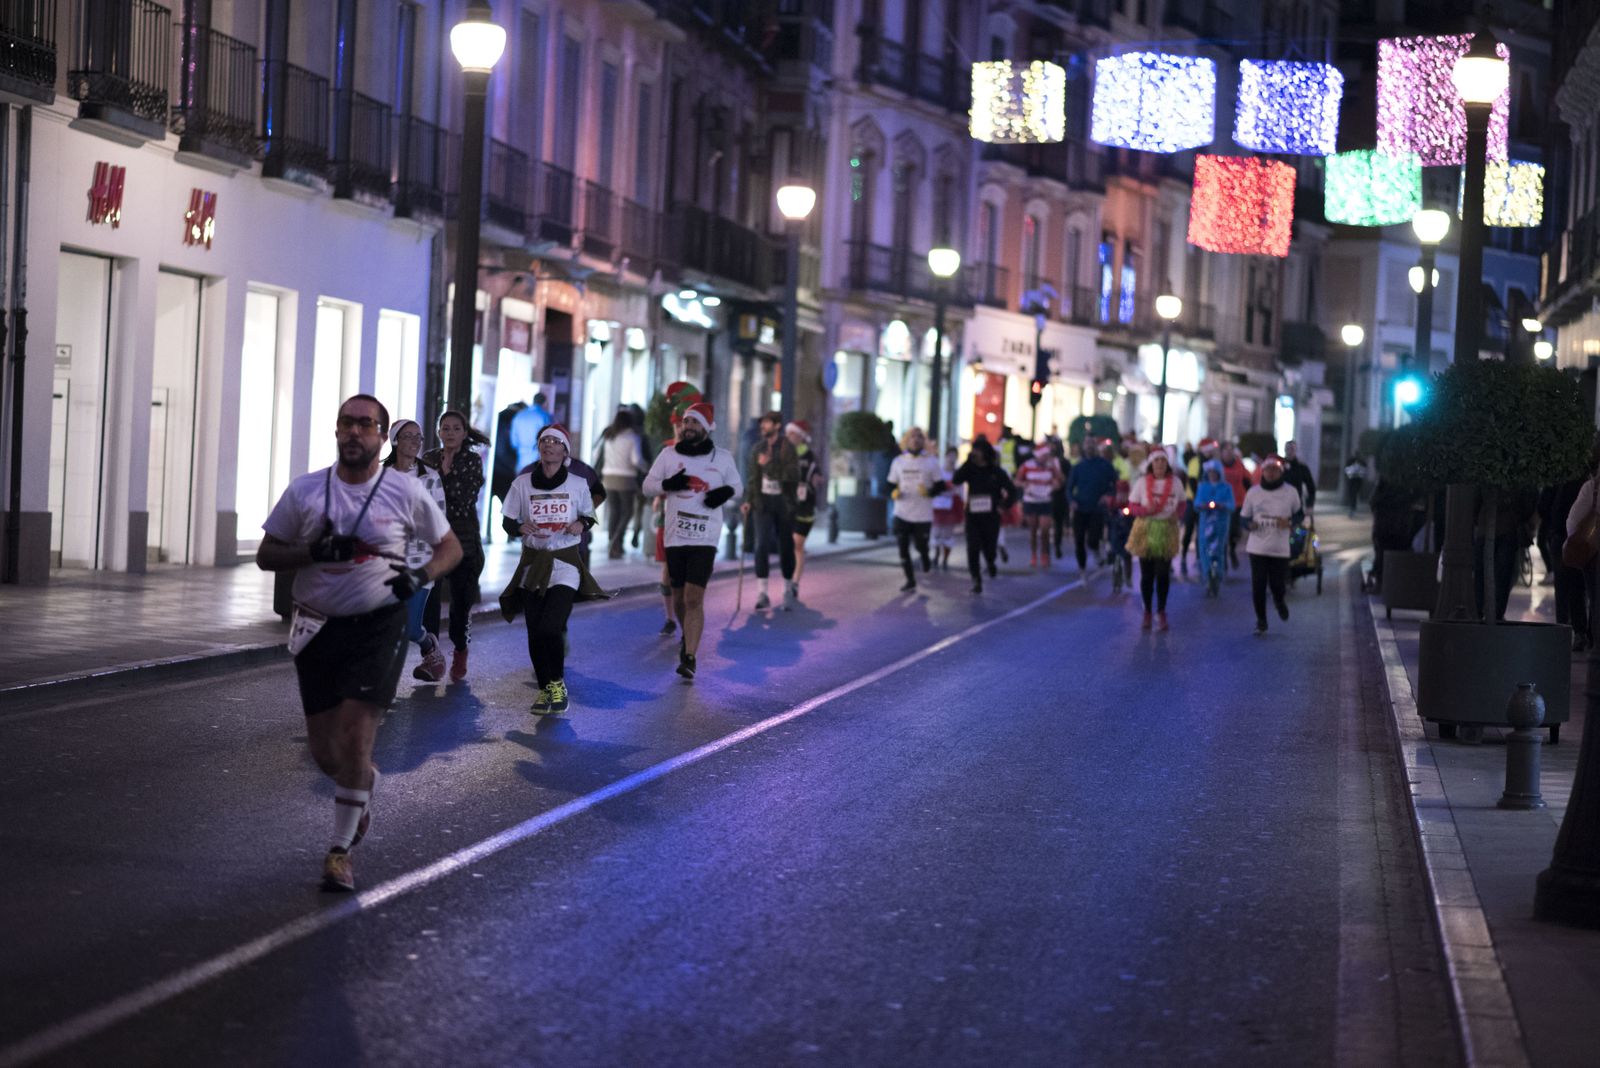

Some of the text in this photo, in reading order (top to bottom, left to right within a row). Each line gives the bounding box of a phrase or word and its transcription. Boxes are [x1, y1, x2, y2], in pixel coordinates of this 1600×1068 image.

[87, 161, 126, 229] H&M
[183, 187, 217, 250] H&M
[533, 503, 567, 515] 2150
[678, 520, 706, 532] 2216
